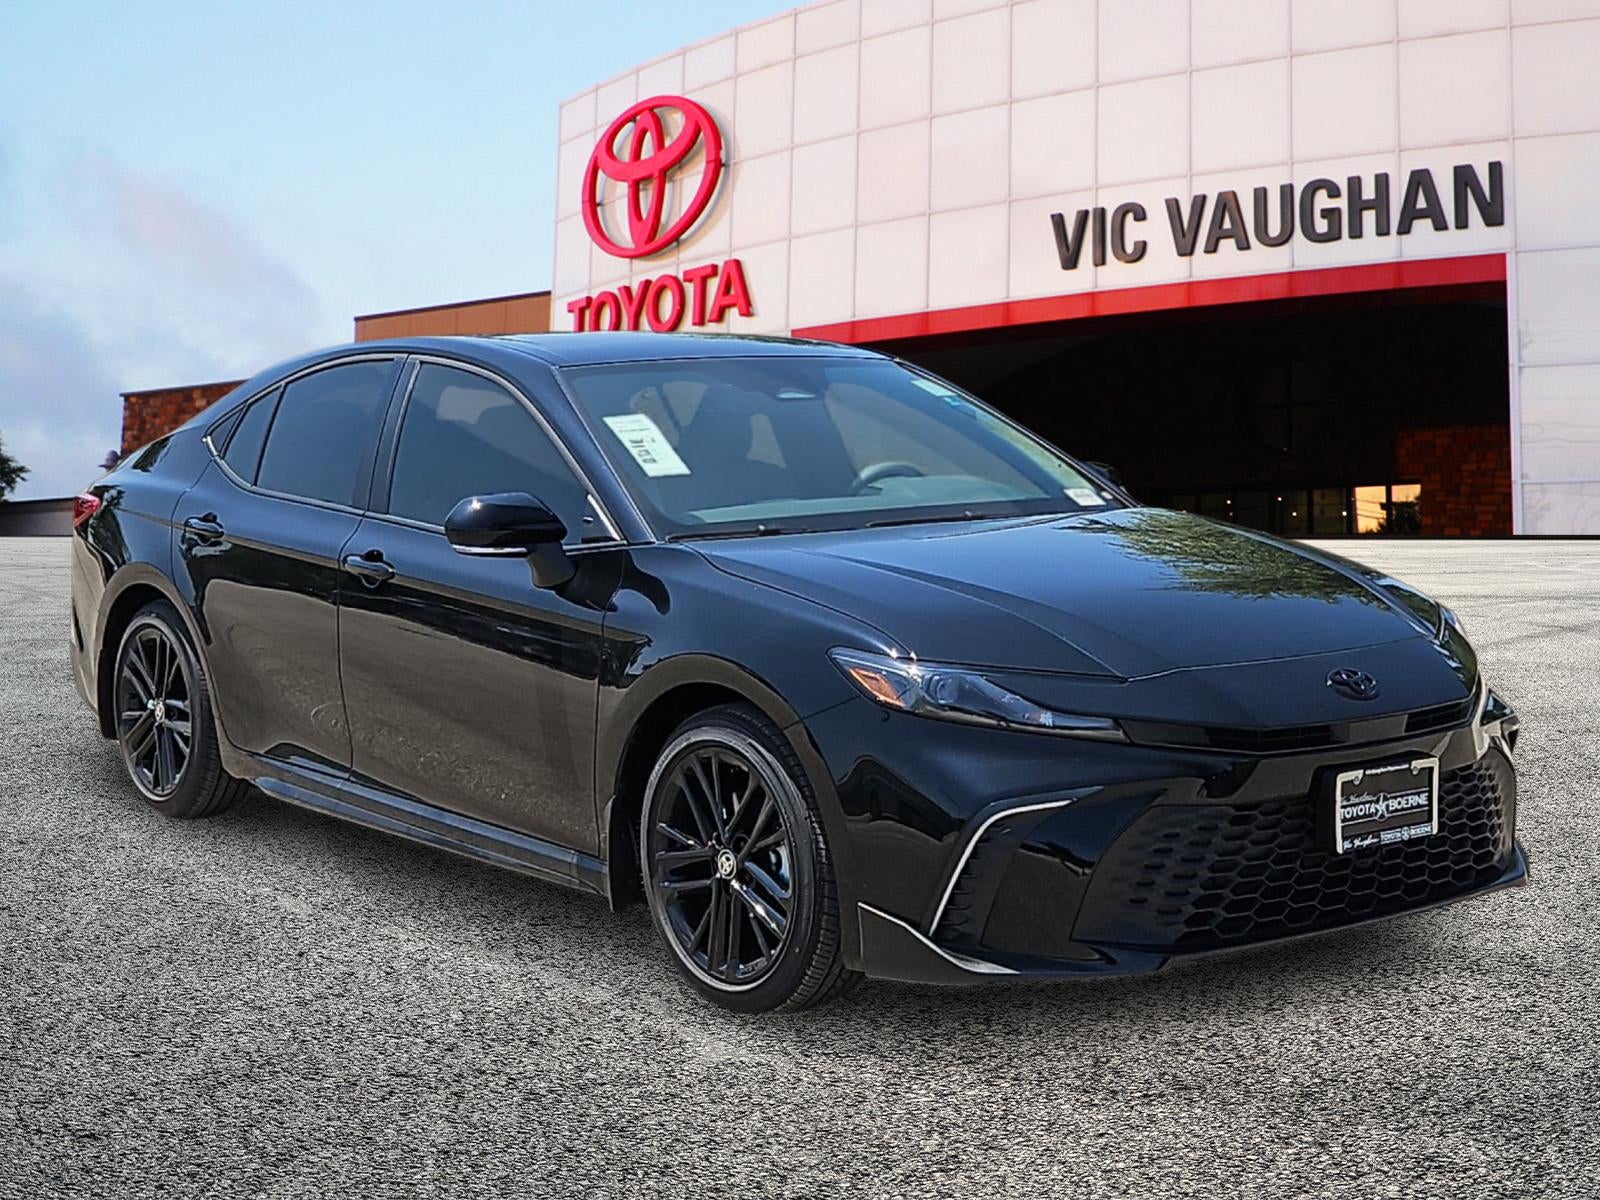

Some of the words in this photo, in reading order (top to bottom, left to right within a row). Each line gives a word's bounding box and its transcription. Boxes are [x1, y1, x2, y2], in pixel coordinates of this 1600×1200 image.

[1050, 201, 1147, 270] VIC
[1165, 160, 1504, 257] VAUGHAN
[568, 258, 754, 332] TOYOTA
[1340, 803, 1376, 819] TOYOTA
[1389, 793, 1429, 811] BOERNE
